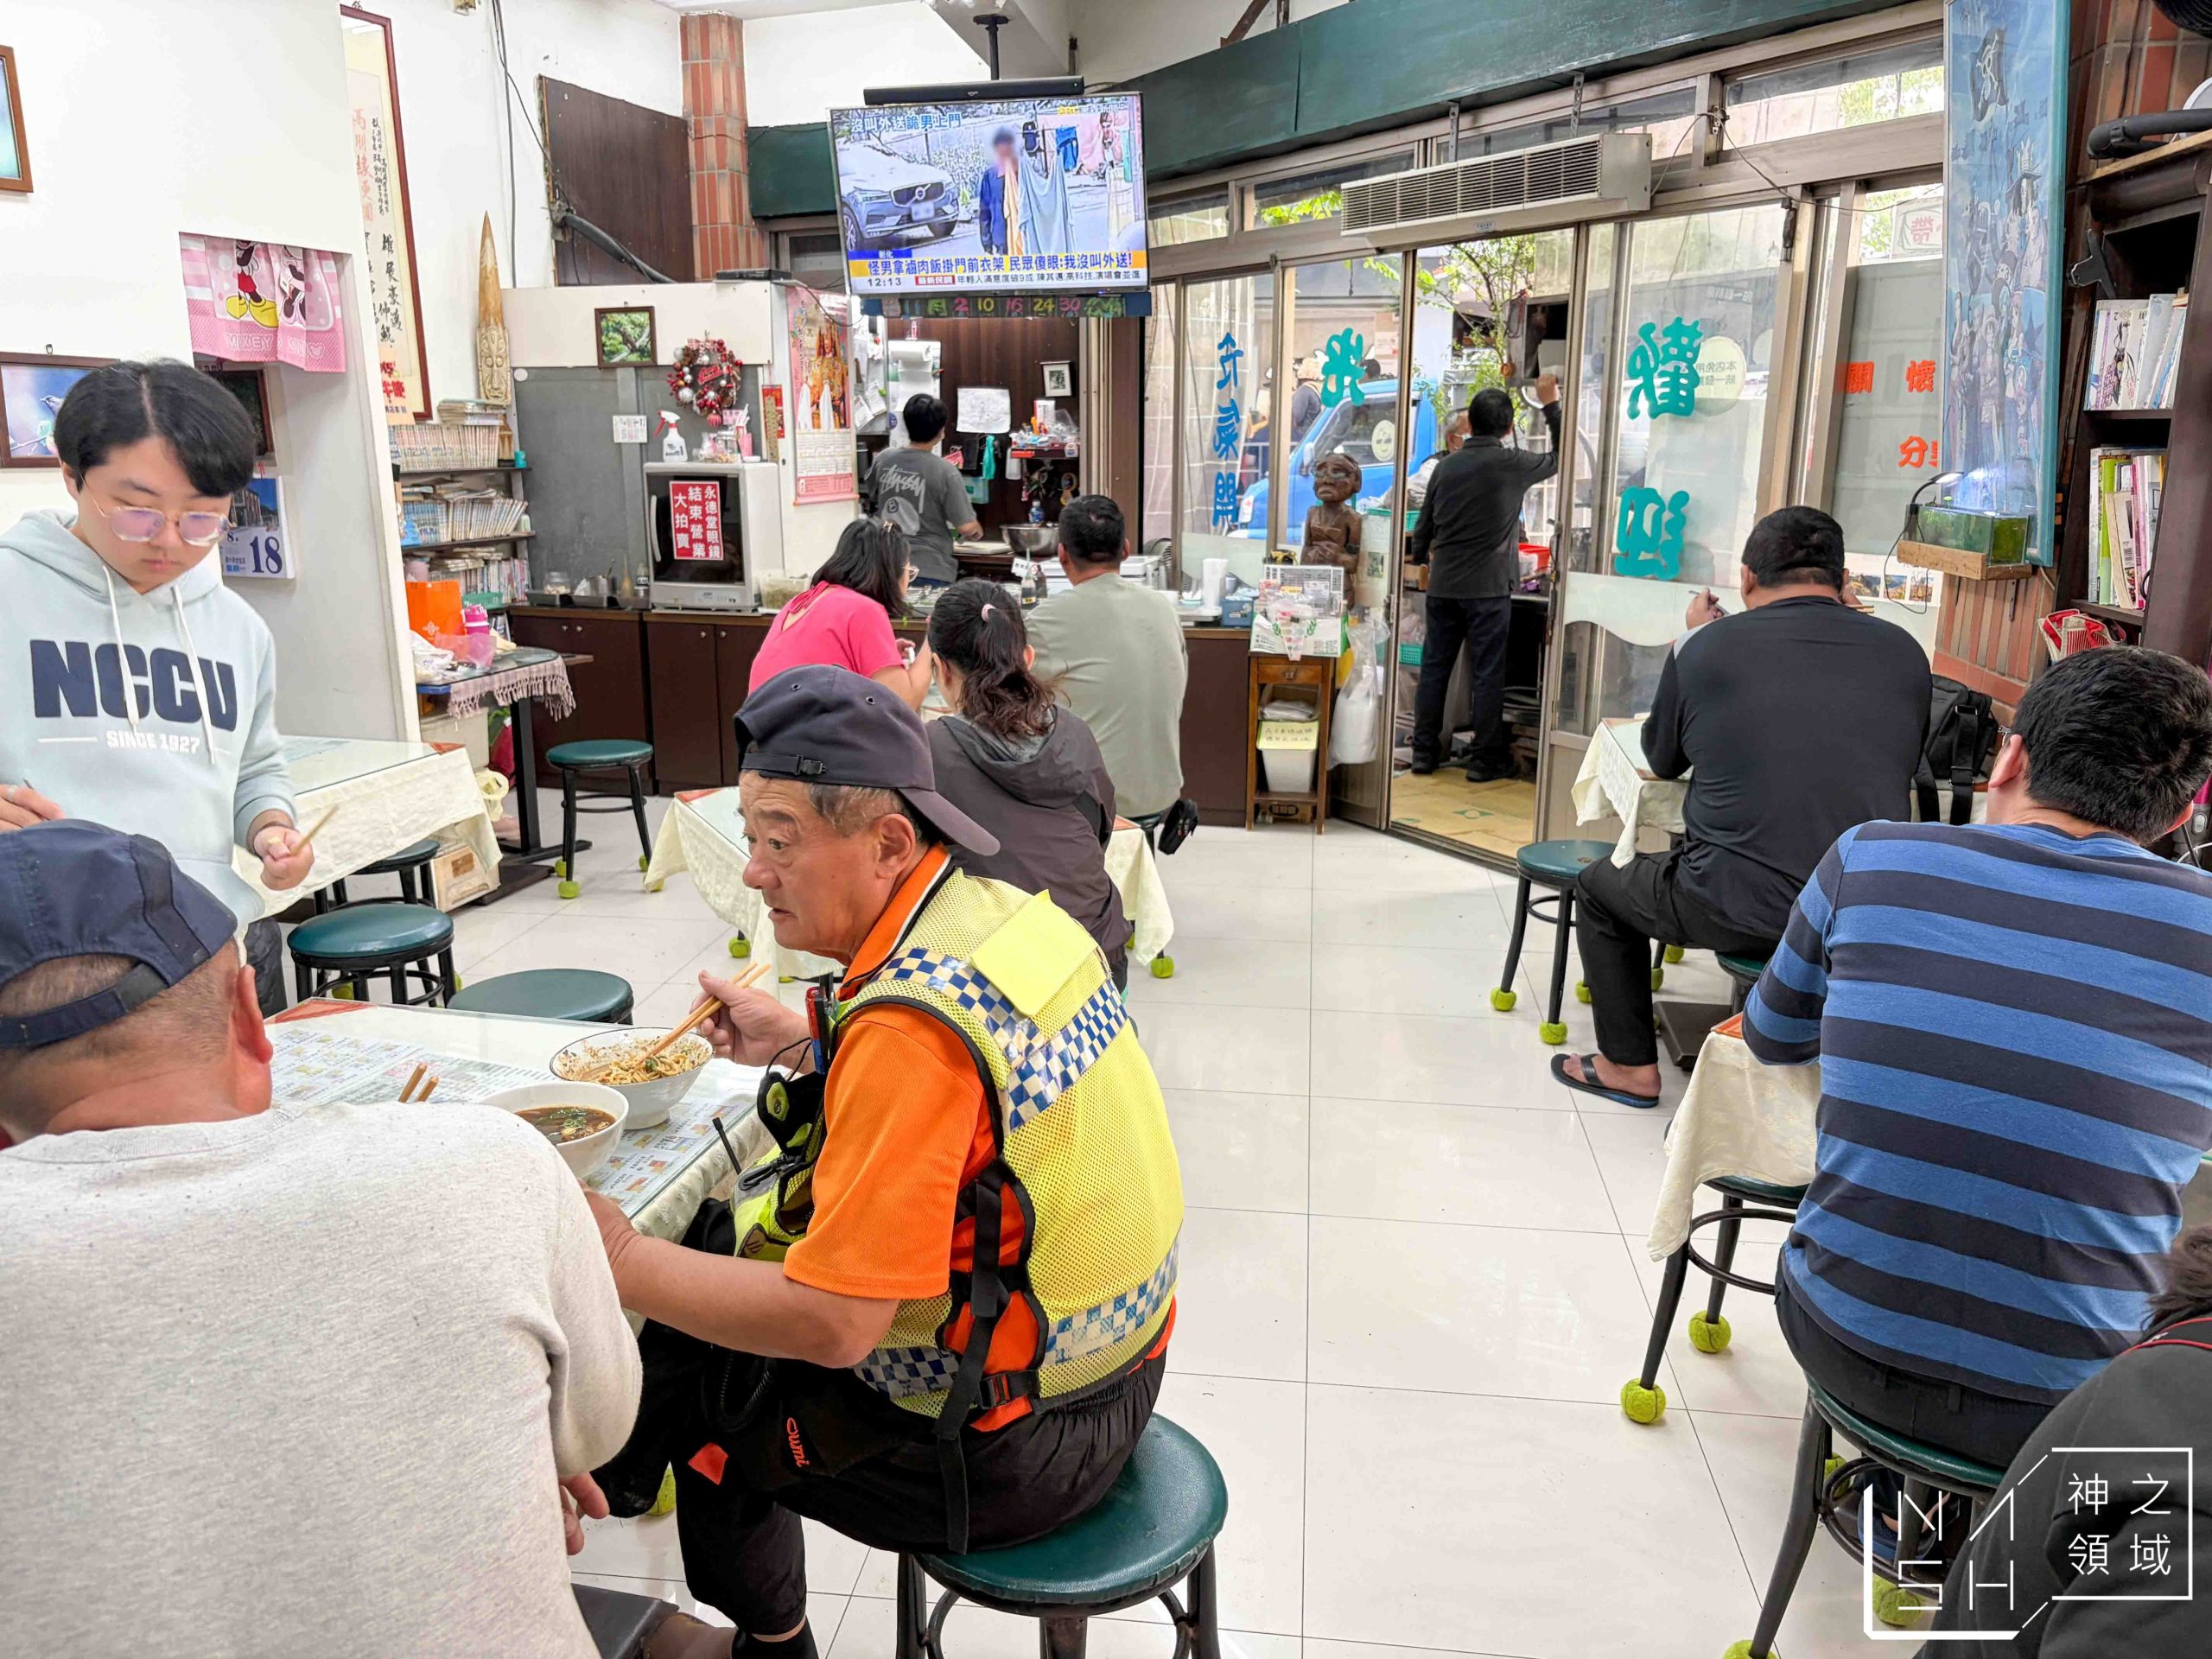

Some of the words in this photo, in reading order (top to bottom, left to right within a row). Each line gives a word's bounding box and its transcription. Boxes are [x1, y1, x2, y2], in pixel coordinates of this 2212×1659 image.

[851, 112, 963, 133] 沒叫外送詭男上門
[868, 256, 1004, 276] 怪男拿滷肉飯掛門前衣架
[868, 277, 902, 287] 12:13
[955, 297, 969, 312] 2
[978, 297, 995, 312] 10
[1006, 297, 1023, 312] 16
[1033, 297, 1055, 313] 24
[1059, 297, 1081, 312] 30
[673, 492, 690, 549] 大拍賣
[688, 486, 706, 558] 結束營業
[704, 486, 721, 558] 永德堂眼鏡
[250, 536, 283, 575] 18
[30, 639, 238, 732] NCCU
[106, 730, 156, 748] SINCE
[160, 733, 200, 753] 1927
